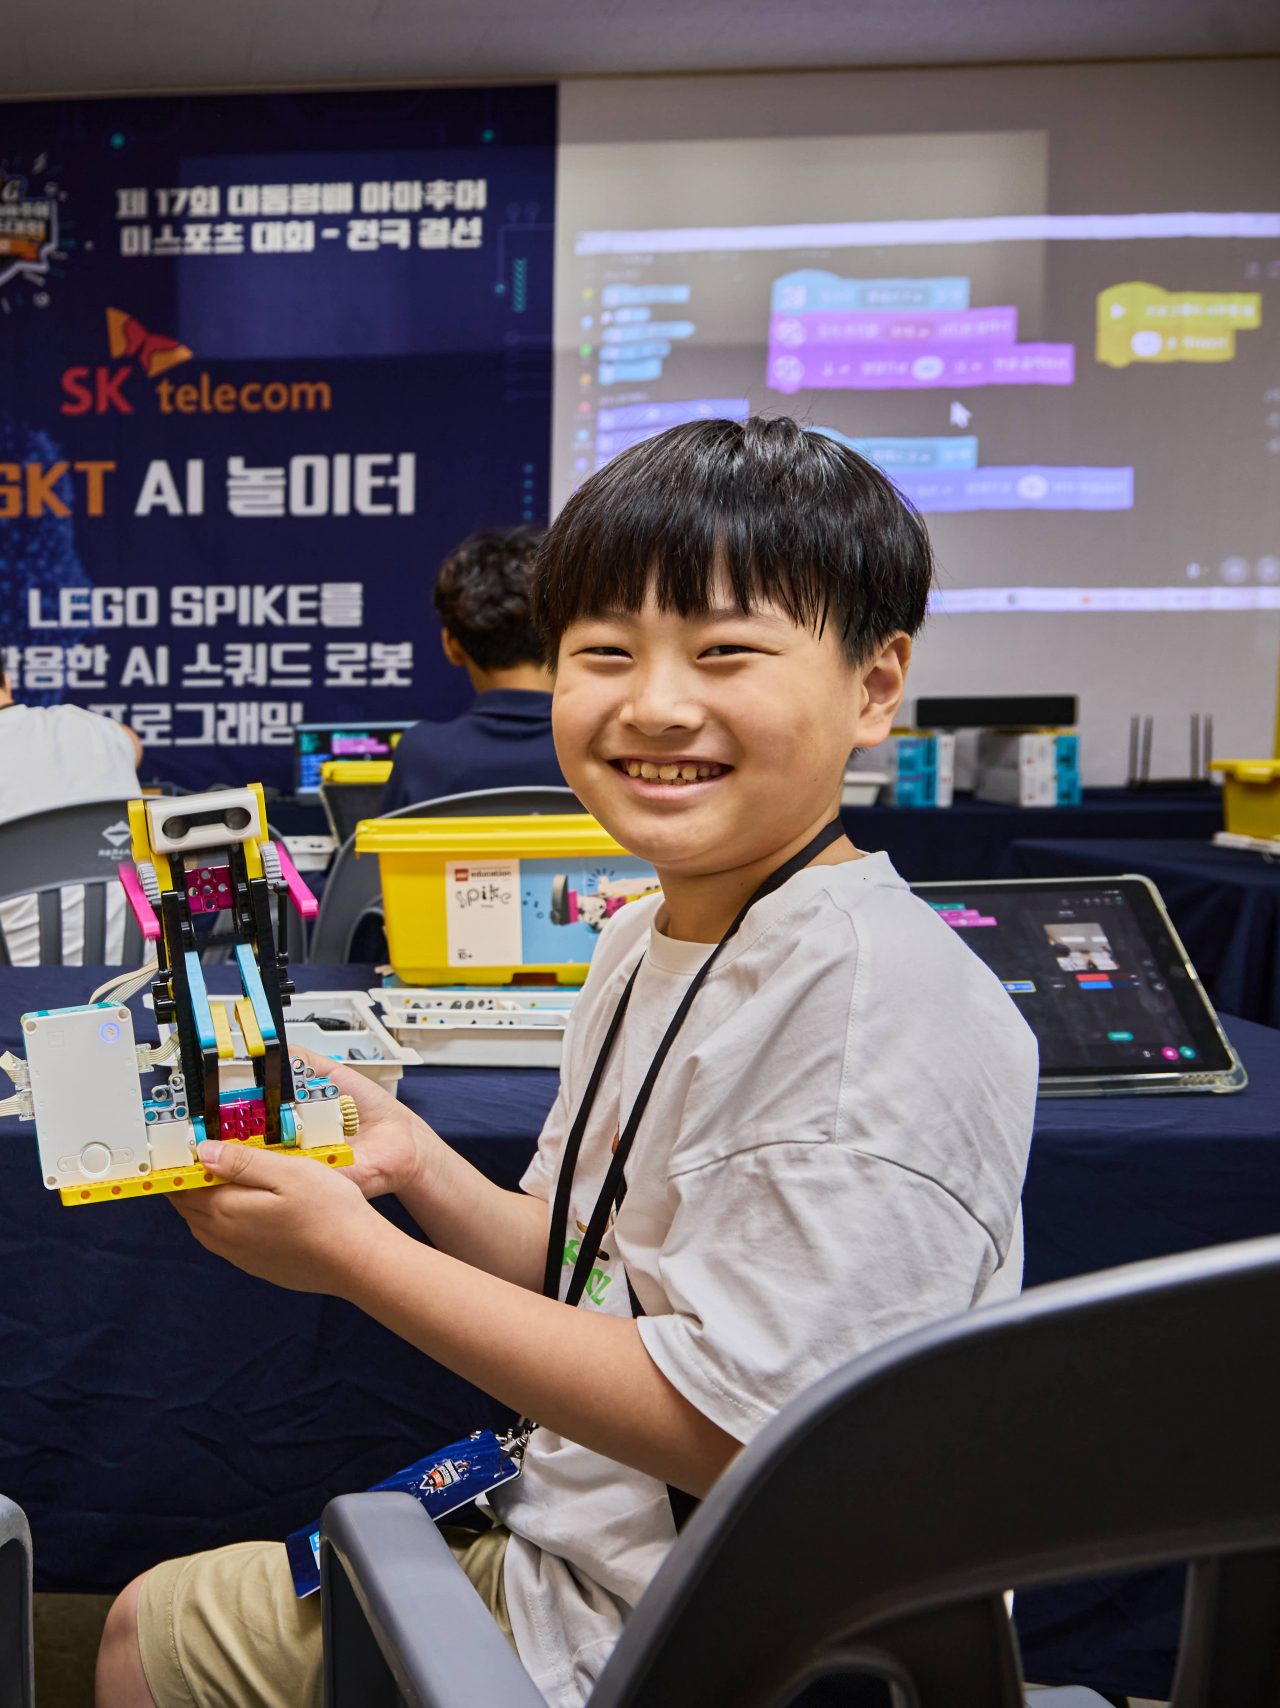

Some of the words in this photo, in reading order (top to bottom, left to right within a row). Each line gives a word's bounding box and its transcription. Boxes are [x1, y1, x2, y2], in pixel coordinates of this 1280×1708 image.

[155, 185, 220, 218] 17회
[360, 178, 487, 213] 아마추어
[121, 221, 244, 256] 이스포츠
[251, 219, 315, 253] 대회
[346, 218, 411, 251] 전국
[418, 215, 483, 249] 결선
[60, 367, 132, 415] SK
[157, 372, 332, 413] telecom
[134, 458, 204, 516] AI
[226, 452, 416, 517] 놀이터
[27, 586, 159, 629] LEGO
[170, 582, 364, 627] SPIKE를
[120, 645, 169, 687] AI
[181, 642, 312, 688] 스쿼드
[324, 641, 413, 687] 로봇
